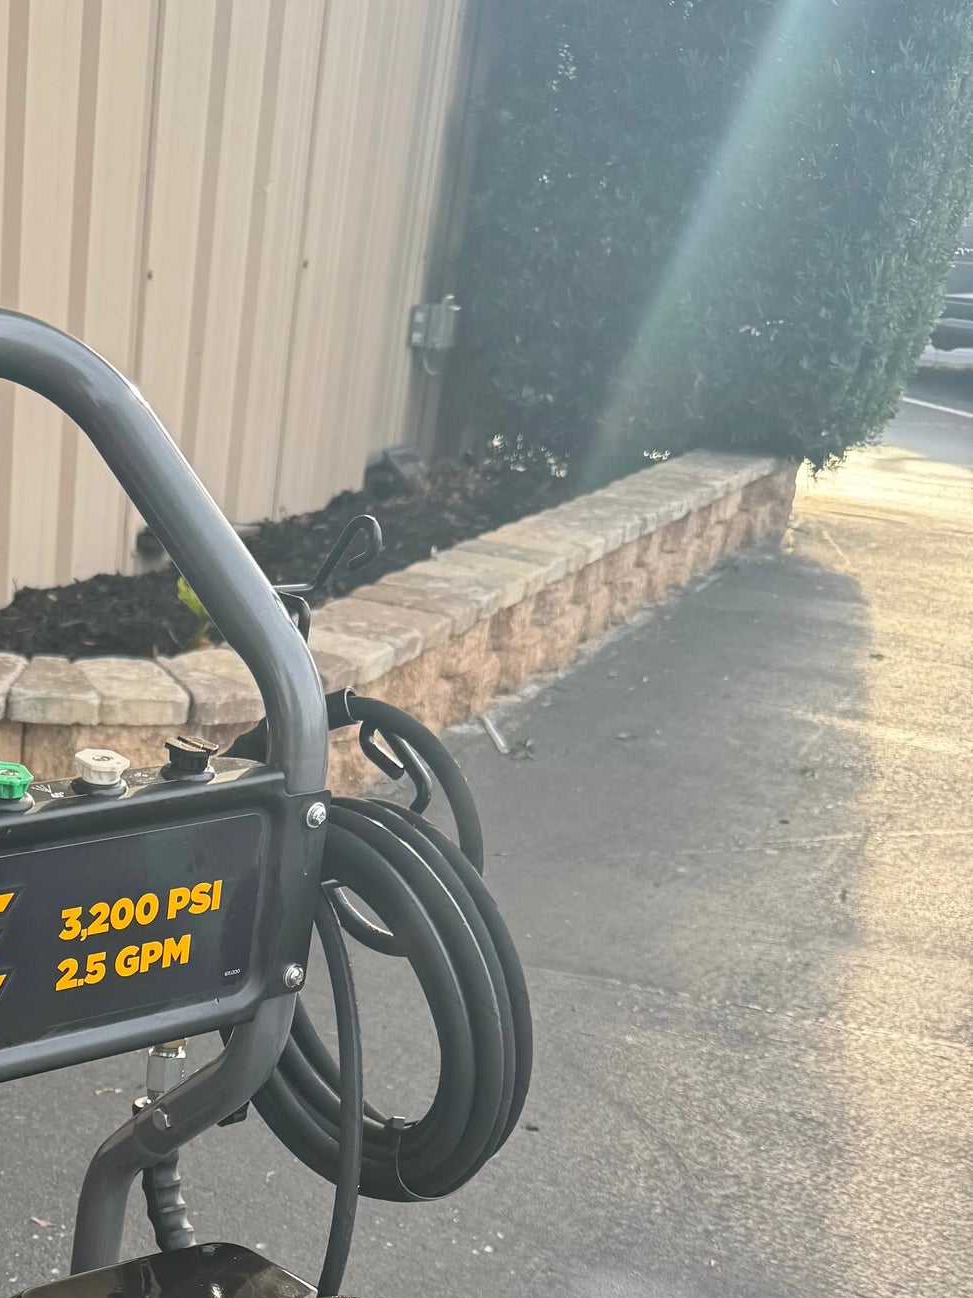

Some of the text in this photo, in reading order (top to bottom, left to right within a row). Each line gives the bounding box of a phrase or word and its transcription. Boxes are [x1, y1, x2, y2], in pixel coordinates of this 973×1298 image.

[58, 880, 223, 942] 3,200 PSI
[55, 934, 192, 992] 2.5 GPM
